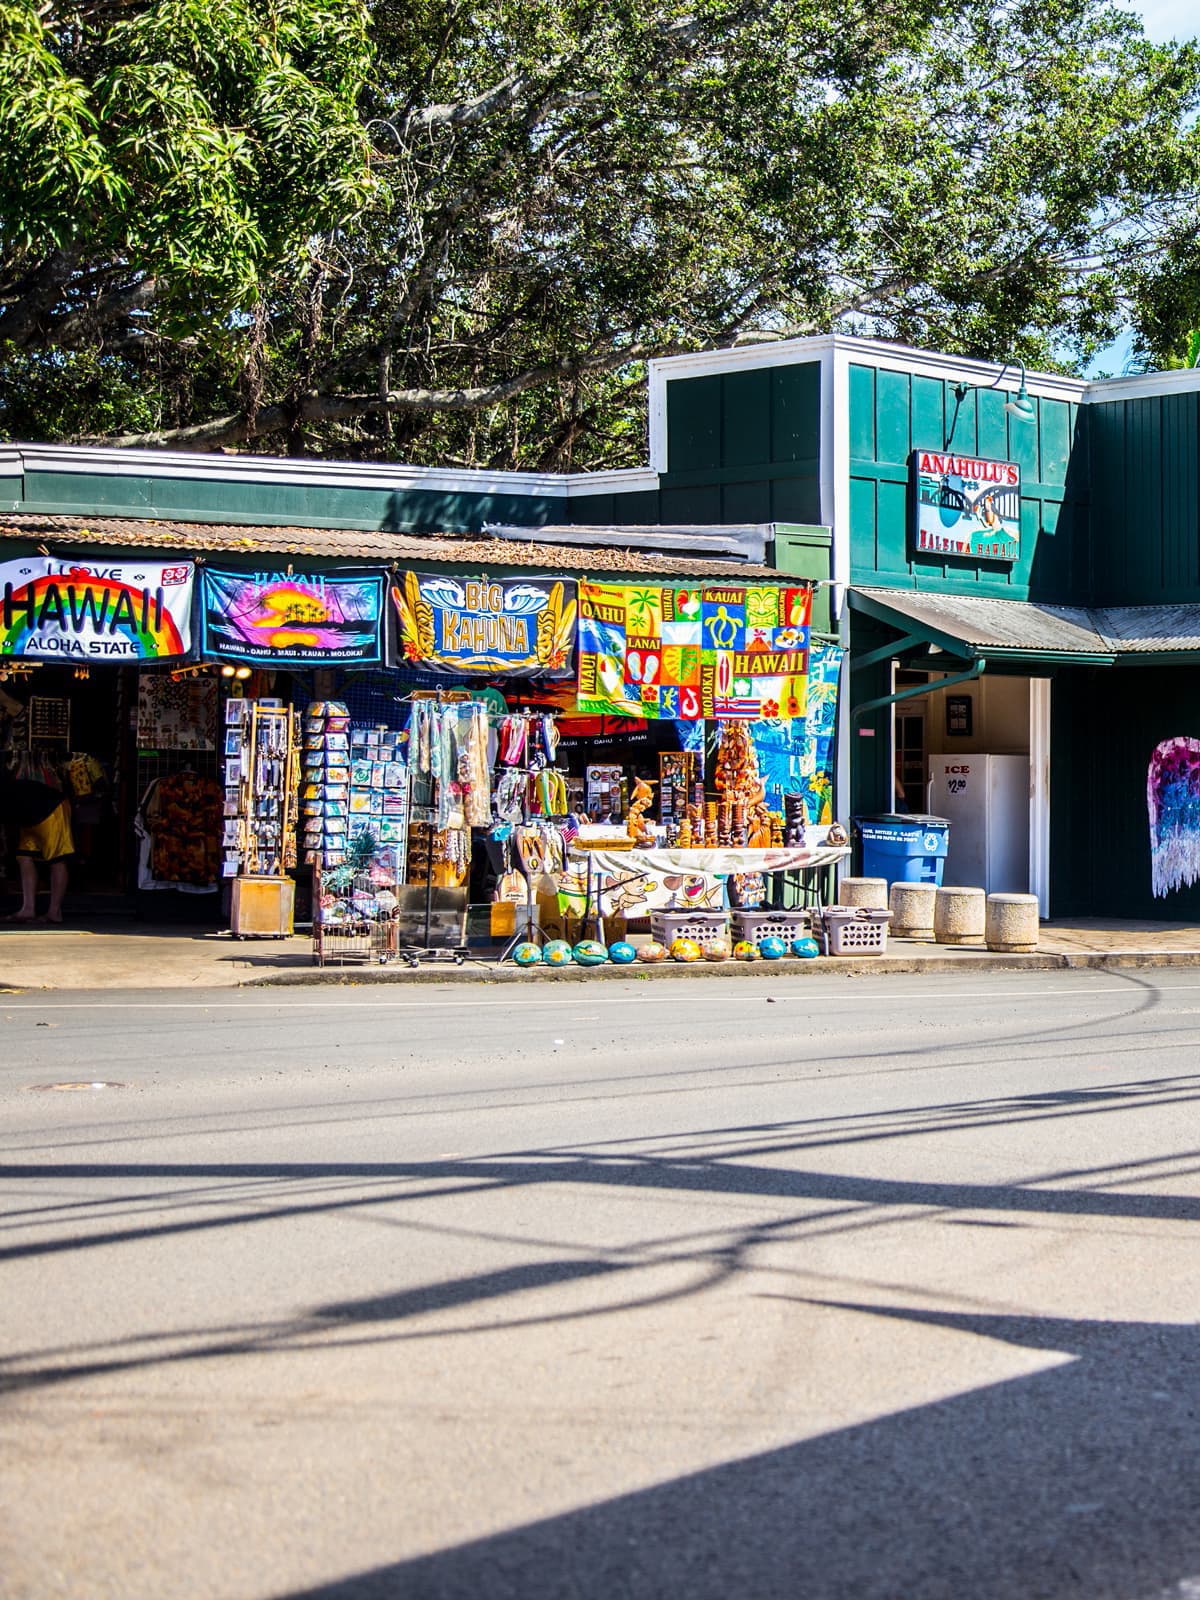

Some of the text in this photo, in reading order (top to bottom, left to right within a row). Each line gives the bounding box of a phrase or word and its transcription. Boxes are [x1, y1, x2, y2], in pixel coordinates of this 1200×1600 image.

[920, 453, 1018, 485] ANAHULU'S
[253, 572, 327, 597] HAWAII
[3, 581, 165, 635] HAWAII
[662, 588, 674, 622] NIIHAU
[705, 591, 743, 604] KAUAI
[581, 606, 625, 623] OAHU
[26, 637, 141, 655] ALOHA STATE
[219, 643, 246, 653] HAWAII
[250, 648, 271, 656] OAHU
[330, 649, 363, 657] MOLOKAI
[627, 637, 661, 650] LANAI
[581, 654, 596, 692] MAUI
[735, 652, 804, 674] HAWAII
[702, 666, 714, 717] MOLOKAI
[944, 765, 970, 774] ICE
